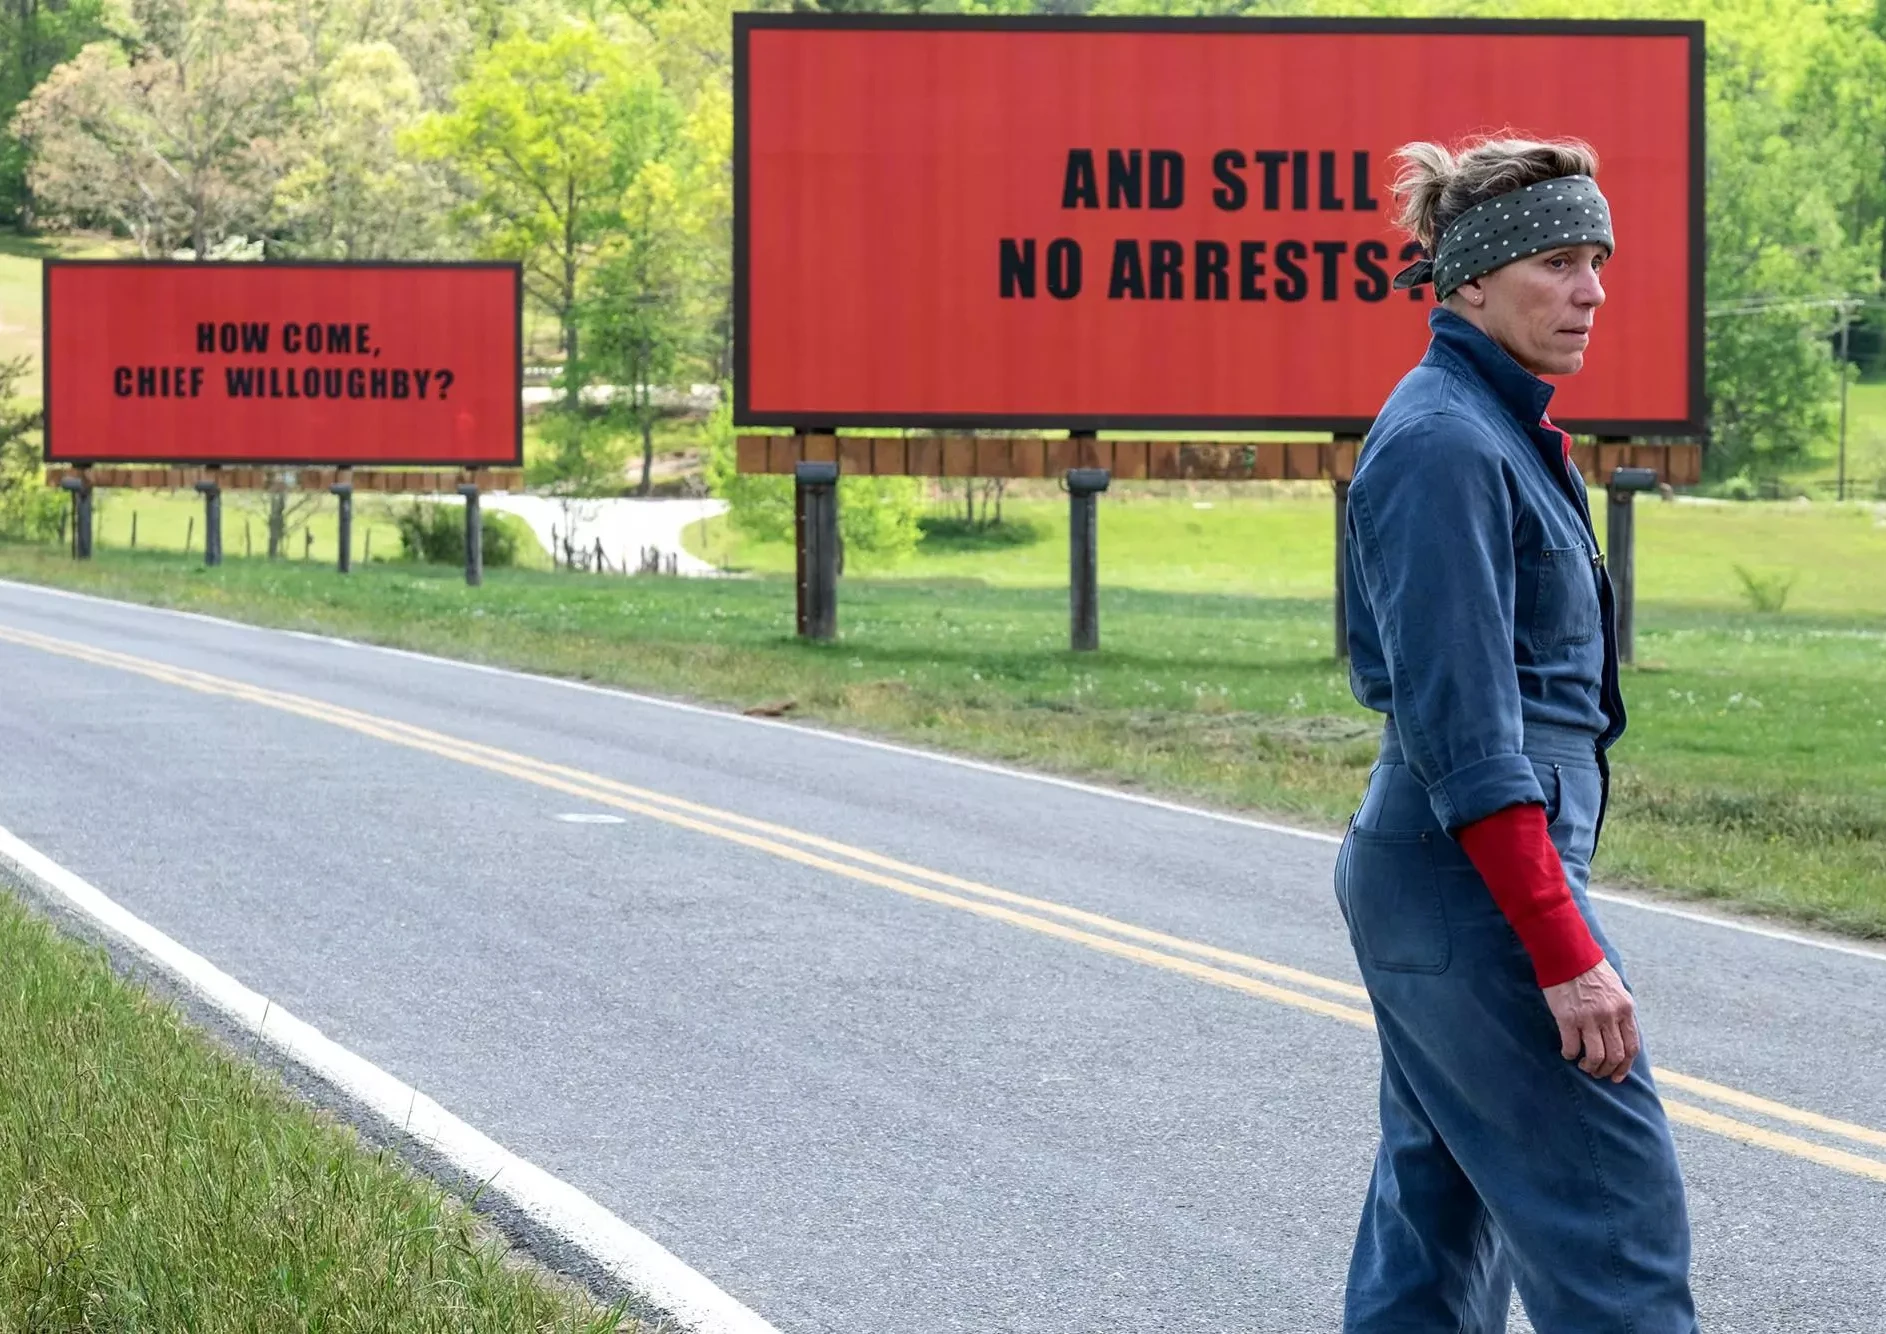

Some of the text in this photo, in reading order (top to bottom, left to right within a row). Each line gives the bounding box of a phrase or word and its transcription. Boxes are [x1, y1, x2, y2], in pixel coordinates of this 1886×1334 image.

[1061, 148, 1378, 212] AND STILL
[999, 237, 1083, 301] NO
[196, 322, 381, 357] HOW COME,
[113, 366, 455, 400] CHIEF WILLOUGHBY?
